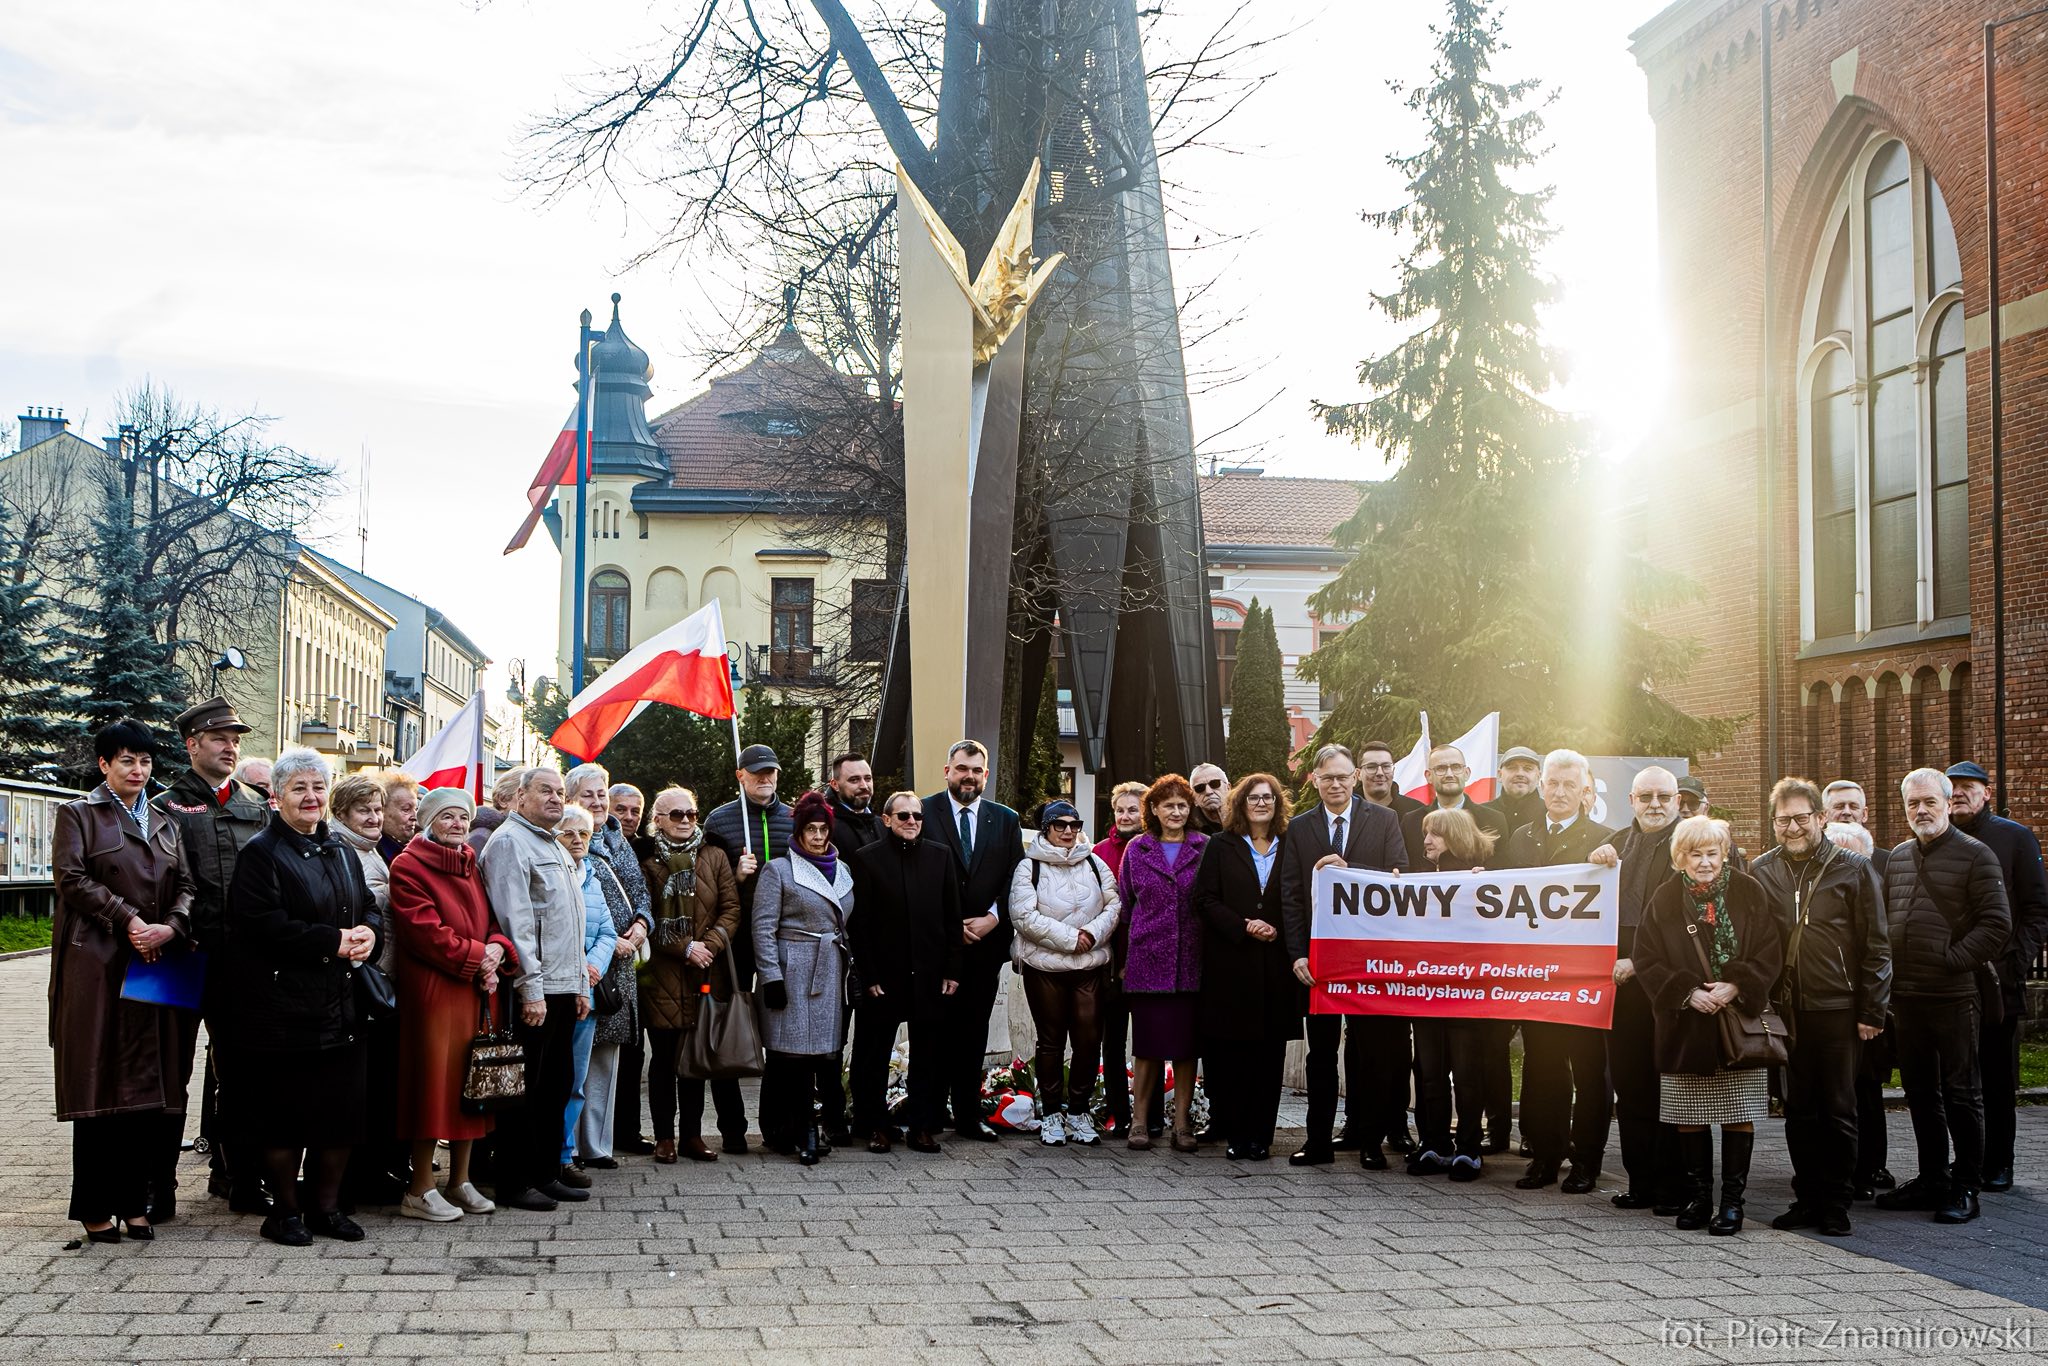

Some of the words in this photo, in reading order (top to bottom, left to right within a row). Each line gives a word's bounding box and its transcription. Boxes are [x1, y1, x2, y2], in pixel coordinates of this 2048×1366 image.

[1332, 882, 1461, 918] NOWY
[1475, 884, 1601, 929] SĄCZ
[1366, 959, 1404, 975] Klub
[1407, 960, 1475, 979] „Gazety
[1479, 963, 1560, 981] Polskiej”
[1327, 981, 1352, 994] im.
[1356, 982, 1381, 995] ks.
[1385, 982, 1486, 1001] Władysława
[1490, 986, 1571, 1003] Gurgacza
[1576, 989, 1602, 1005] SJ
